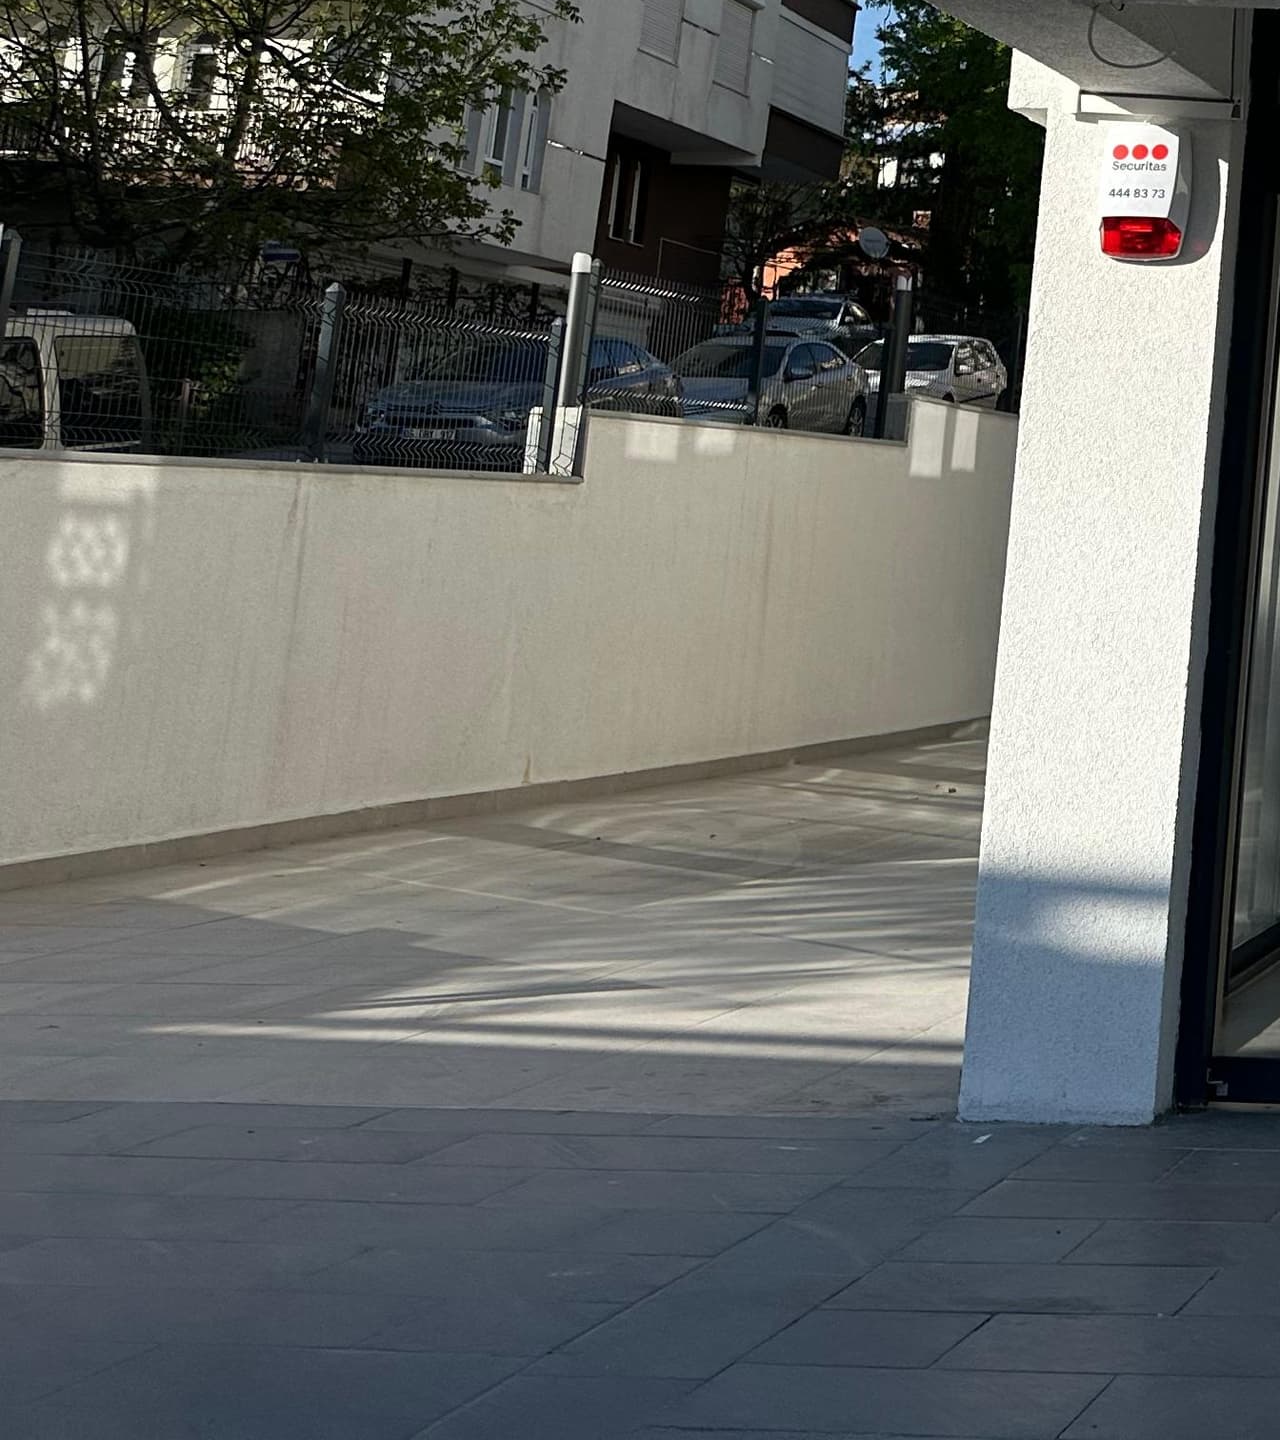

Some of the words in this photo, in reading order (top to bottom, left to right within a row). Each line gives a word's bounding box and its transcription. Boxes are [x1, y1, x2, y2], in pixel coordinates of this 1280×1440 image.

[1111, 161, 1167, 172] Securitas
[1109, 188, 1130, 198] 444
[1133, 188, 1148, 199] 83
[1151, 189, 1166, 199] 73
